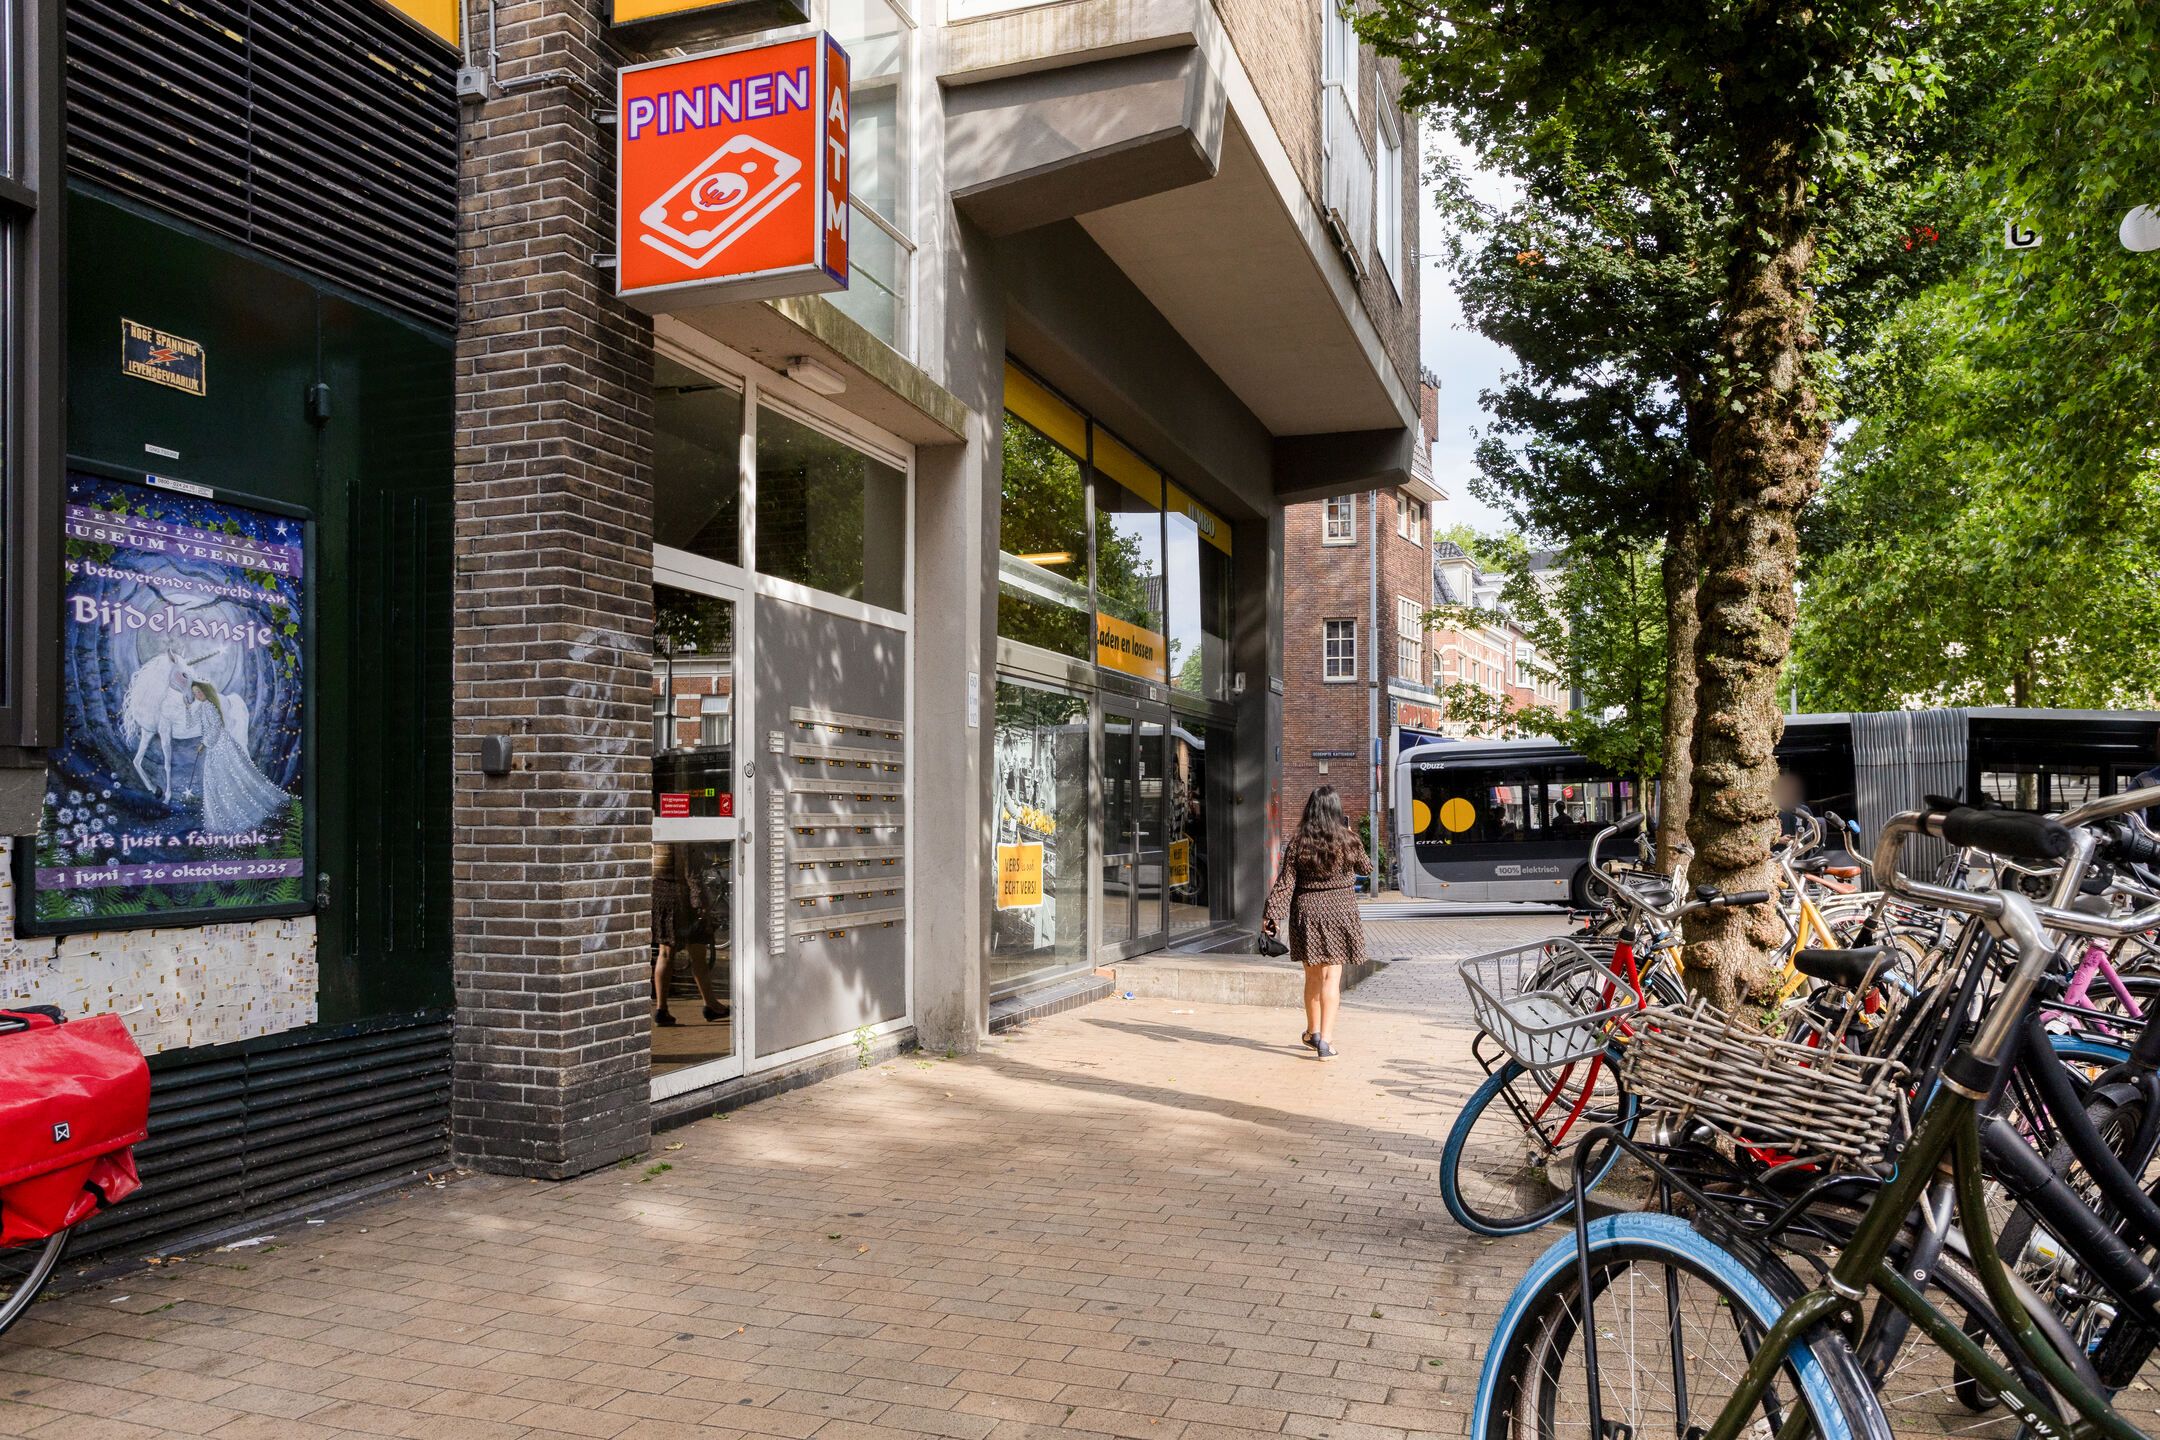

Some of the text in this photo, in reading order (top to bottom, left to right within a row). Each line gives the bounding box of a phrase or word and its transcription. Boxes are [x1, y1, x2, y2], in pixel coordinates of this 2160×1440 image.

[627, 66, 810, 141] PINNEN
[826, 86, 847, 242] ATM
[130, 325, 198, 357] HOGE SPANNING
[71, 508, 289, 556] EENKOLONIAAL
[177, 543, 290, 573] VEENDAM
[85, 560, 193, 590] betoverende
[198, 583, 252, 599] wereld
[257, 592, 287, 604] van
[67, 595, 273, 650] Bijdehansje
[1097, 626, 1153, 661] aden en lossen
[1420, 762, 1445, 771] Qbuzz
[80, 833, 115, 848] It's
[121, 833, 162, 850] just
[168, 835, 182, 847] a
[186, 831, 267, 848] fairytale
[57, 872, 65, 883] 1
[75, 869, 119, 886] juni
[143, 868, 166, 879] 26
[172, 865, 243, 878] oktober
[247, 863, 288, 875] 2025
[1005, 858, 1020, 872] VERS
[1500, 865, 1560, 875] 100% elektrisch
[1005, 880, 1037, 895] ECHT VERS!
